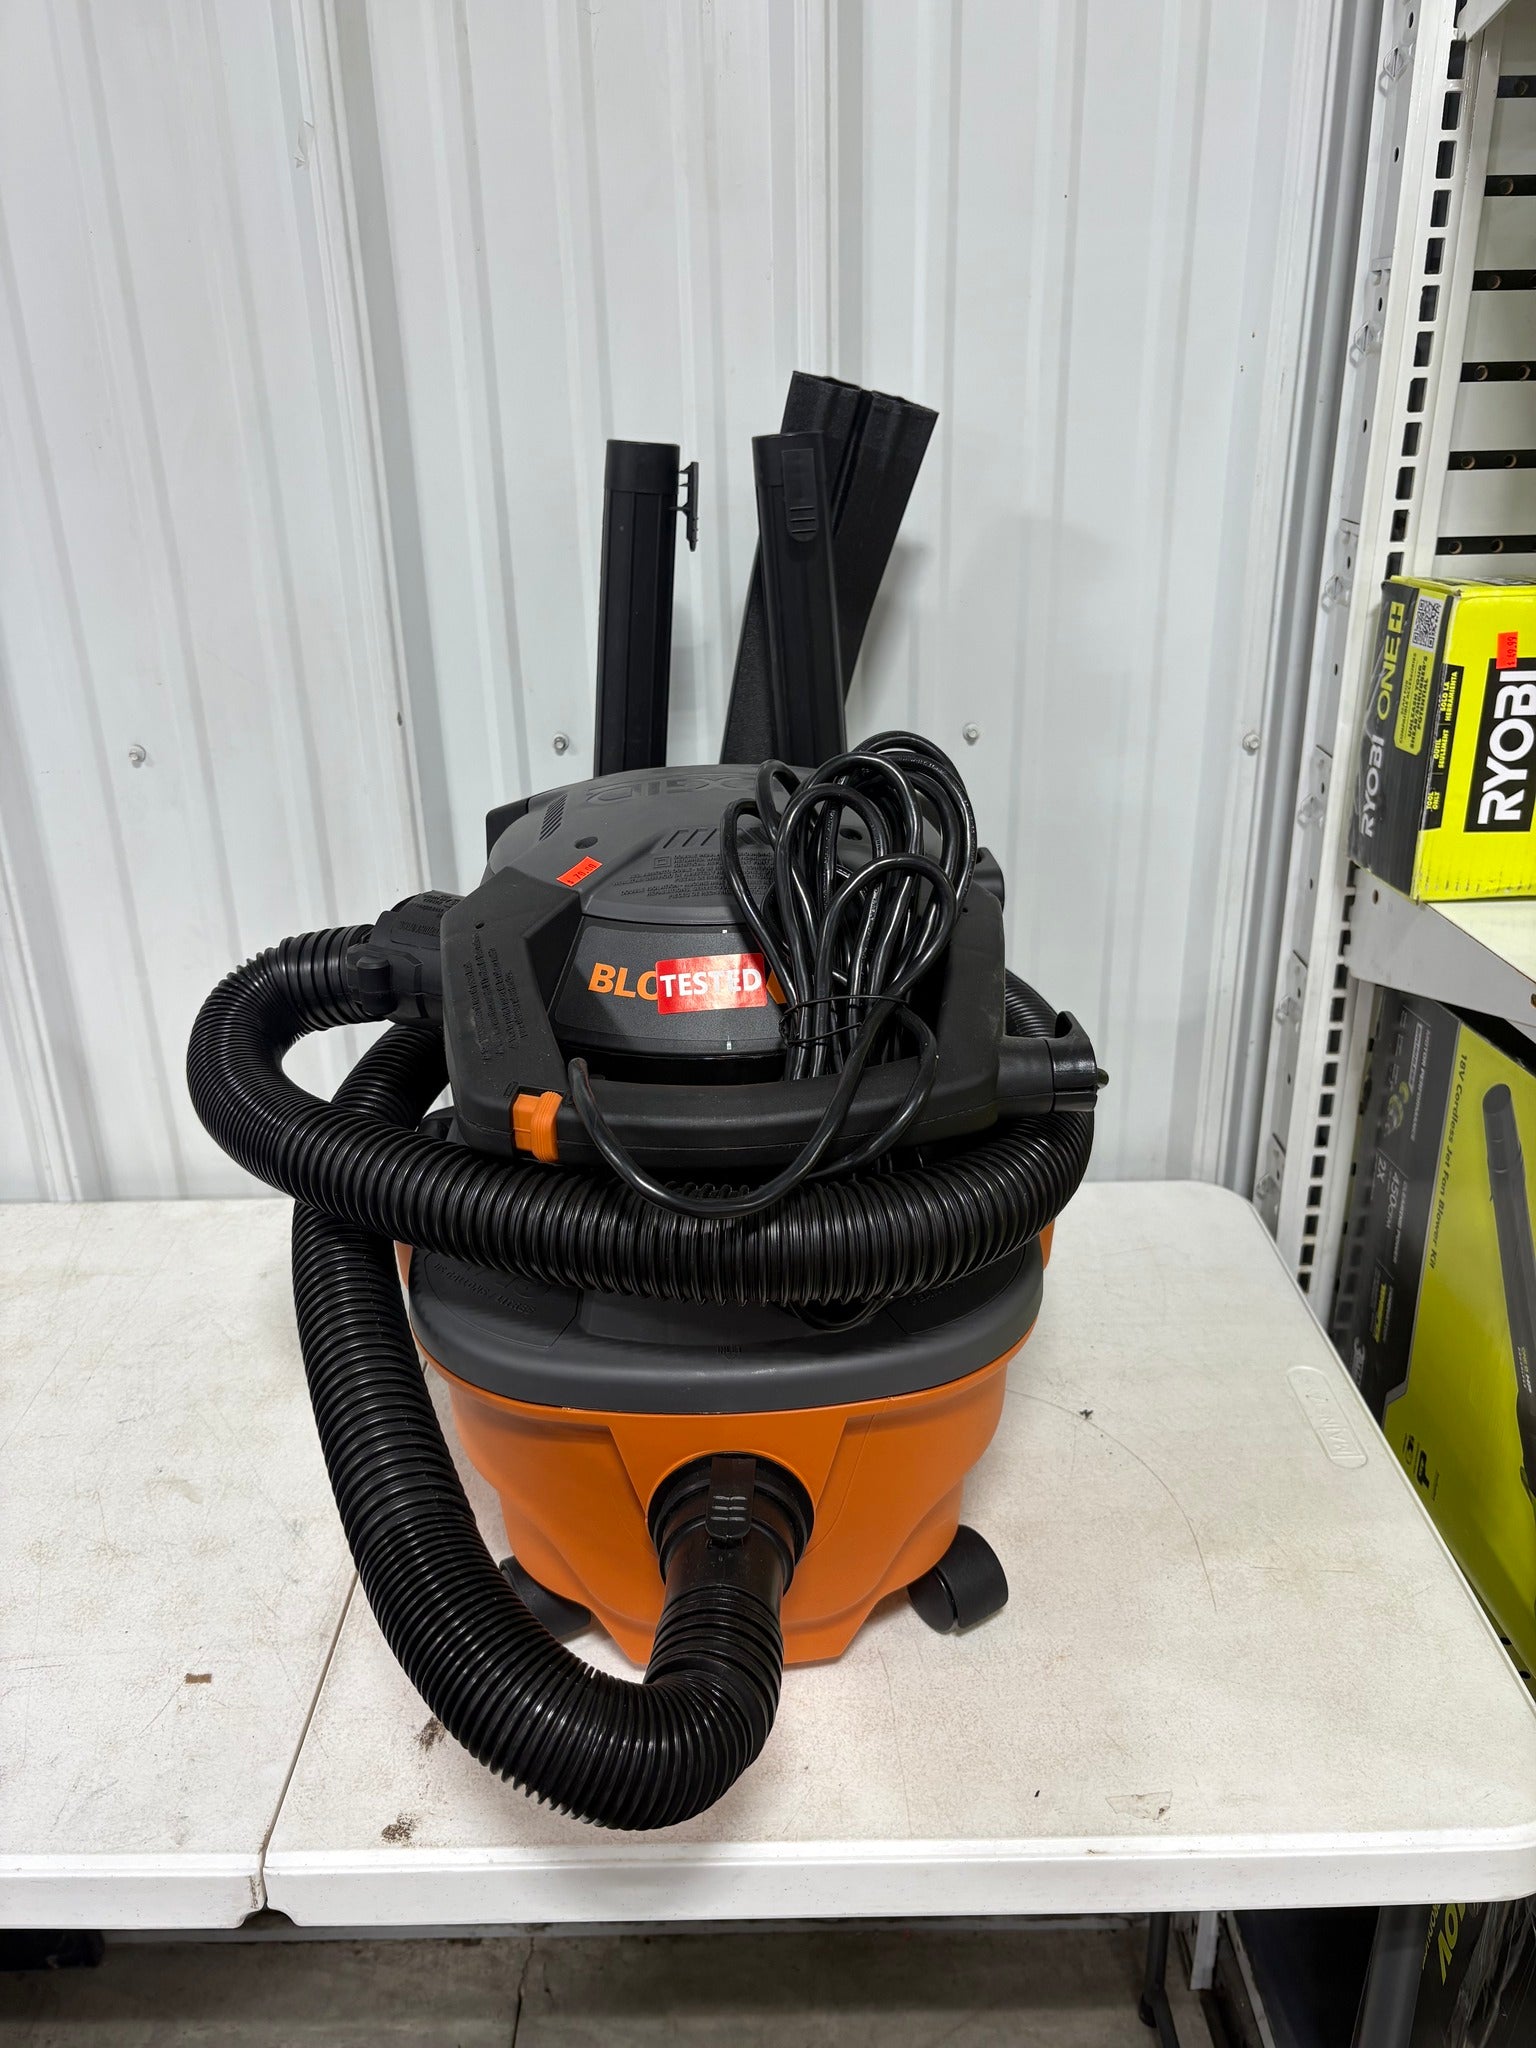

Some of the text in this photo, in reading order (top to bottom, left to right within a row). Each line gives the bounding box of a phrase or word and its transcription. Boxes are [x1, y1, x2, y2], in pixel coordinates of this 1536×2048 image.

[1417, 678, 1429, 730] POTENTIAL
[1440, 680, 1450, 712] SOLO LA
[1445, 671, 1458, 722] HERRAMIENTA
[1433, 738, 1442, 760] OUTIL
[1438, 729, 1450, 769] SEULEMENT
[1477, 670, 1536, 825] RYOBI
[1360, 734, 1385, 837] RYOBI
[1426, 791, 1434, 810] TOOL
[1432, 791, 1440, 810] ONLY
[588, 962, 659, 1001] BLO
[660, 968, 763, 998] TESTED
[1429, 1054, 1468, 1270] 18V Cordless Jet Fan Blower Kit
